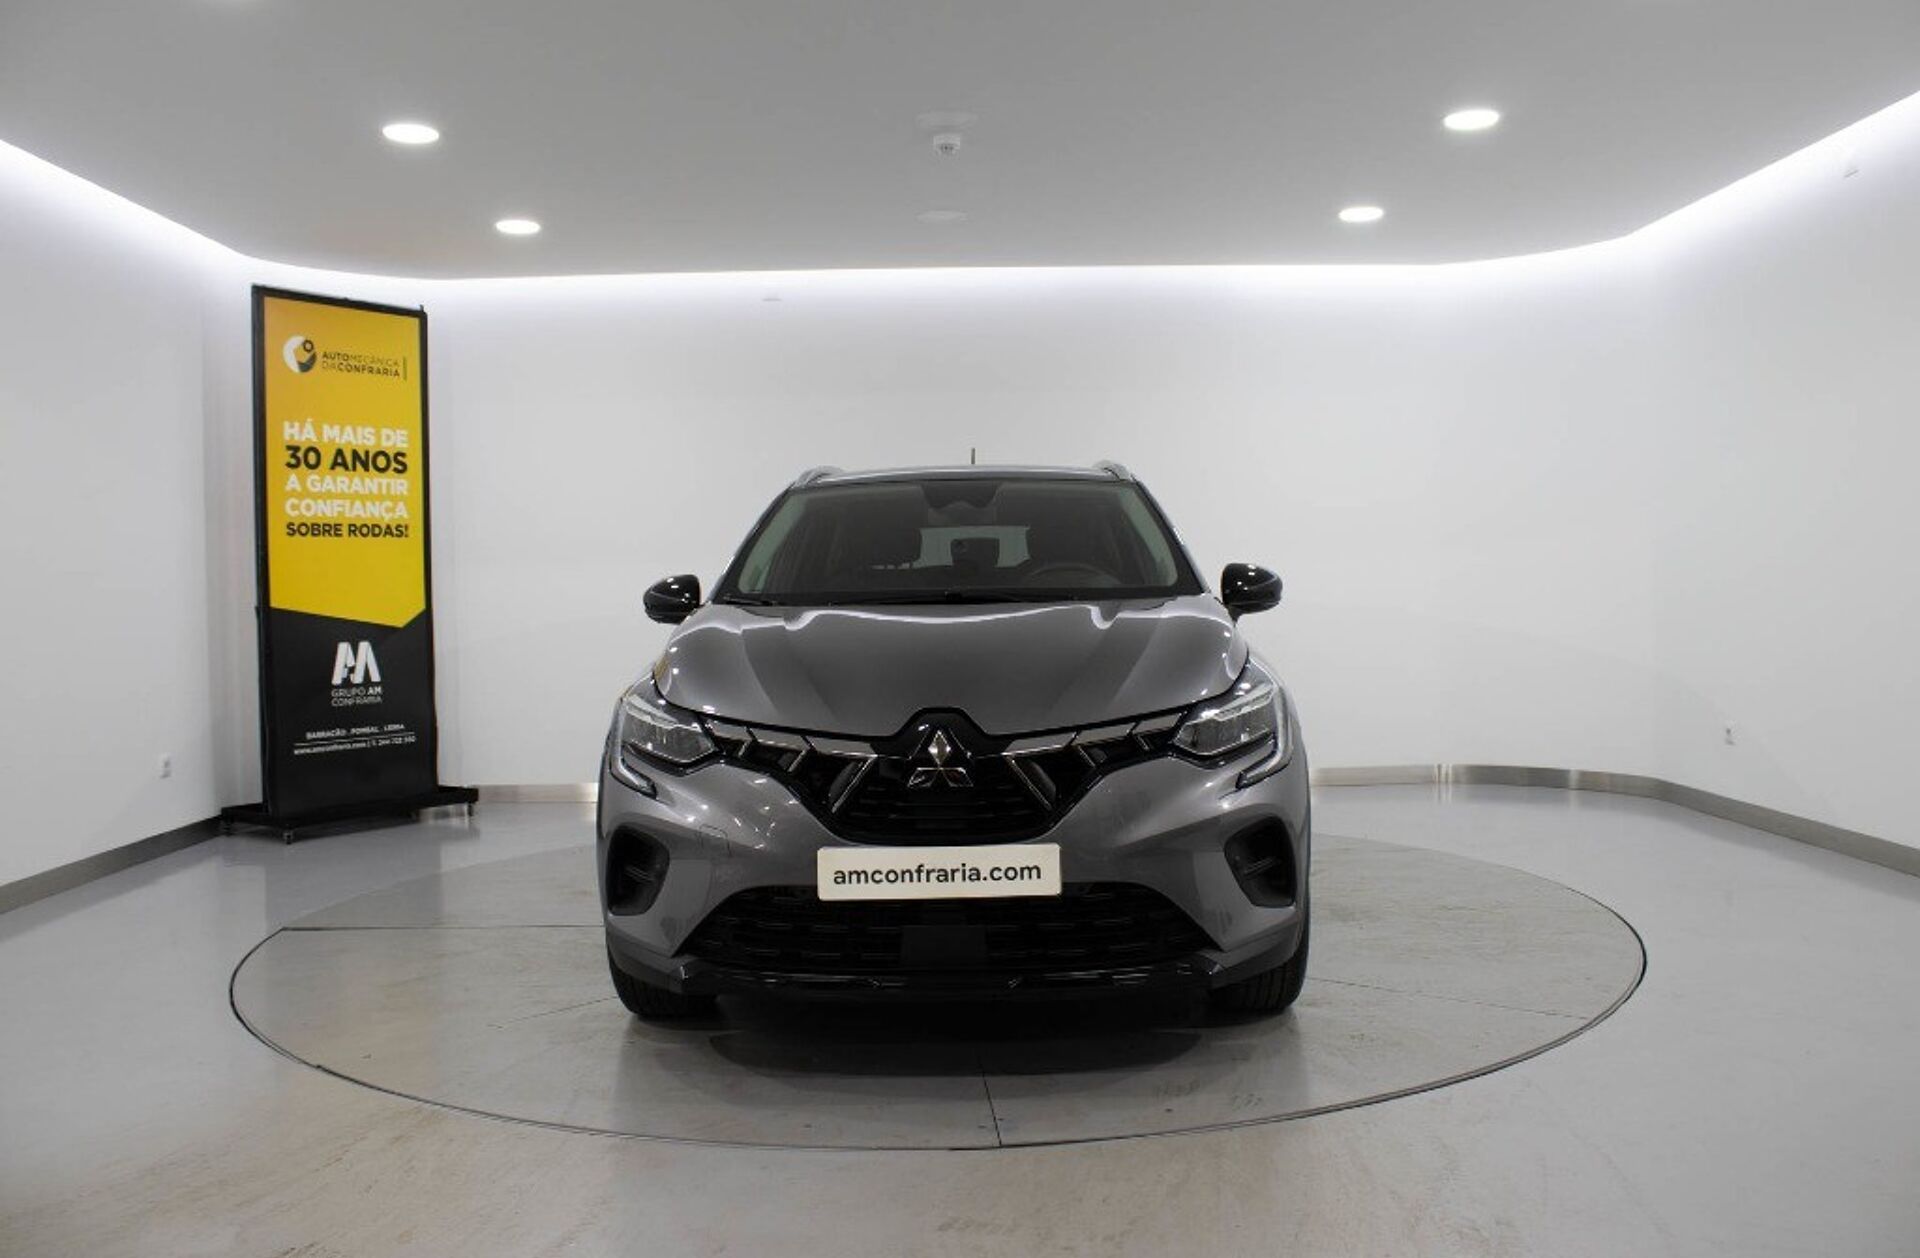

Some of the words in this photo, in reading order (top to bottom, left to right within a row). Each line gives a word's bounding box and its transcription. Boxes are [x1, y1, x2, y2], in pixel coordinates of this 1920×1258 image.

[283, 418, 317, 442] HÁ
[322, 424, 376, 445] MAIS
[381, 428, 409, 447] DE
[285, 445, 322, 470] 30
[330, 448, 408, 474] ANOS
[285, 473, 301, 492] A
[306, 474, 409, 495] GARANTIR
[285, 497, 409, 521] CONFIANÇA
[286, 522, 343, 537] SOBRE
[348, 524, 409, 538] RODAS!
[331, 687, 366, 697] GRUPO
[367, 686, 382, 695] AM
[833, 863, 1042, 885] amconfraria.com
